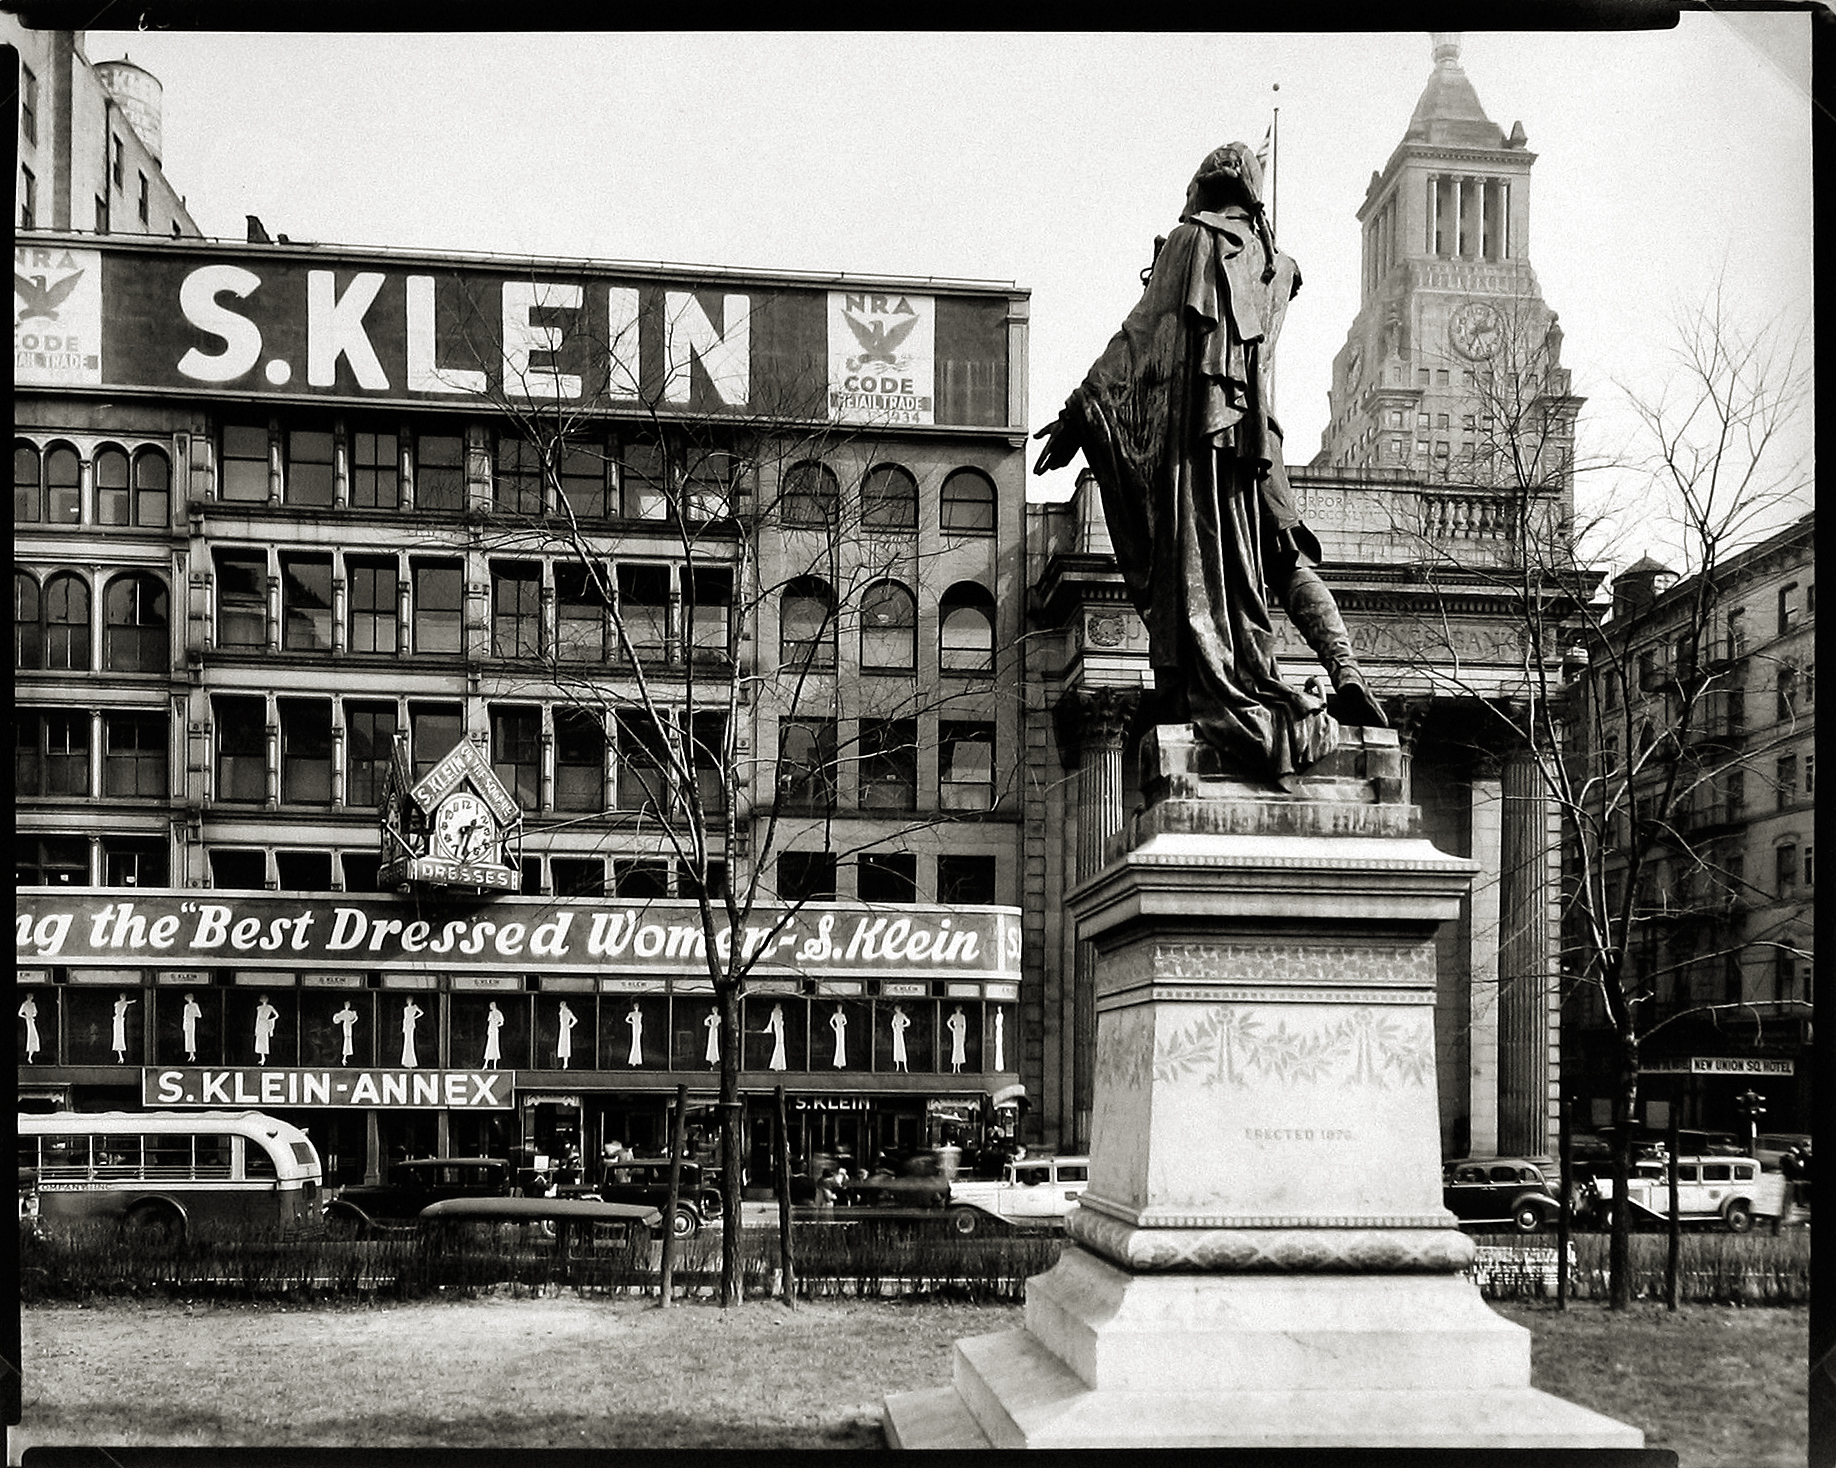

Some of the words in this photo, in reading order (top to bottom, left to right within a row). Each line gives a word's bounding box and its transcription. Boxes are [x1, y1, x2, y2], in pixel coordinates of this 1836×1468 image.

[845, 294, 915, 315] NRA
[844, 376, 914, 394] CODE
[882, 396, 922, 410] TRADE
[422, 864, 509, 885] DRESSES
[90, 904, 180, 949] the
[325, 907, 574, 955] Dressed
[1694, 1060, 1713, 1071] NEW
[1716, 1060, 1744, 1071] UNION
[1764, 1061, 1791, 1072] HOTEL
[1244, 1128, 1314, 1140] ERECTED
